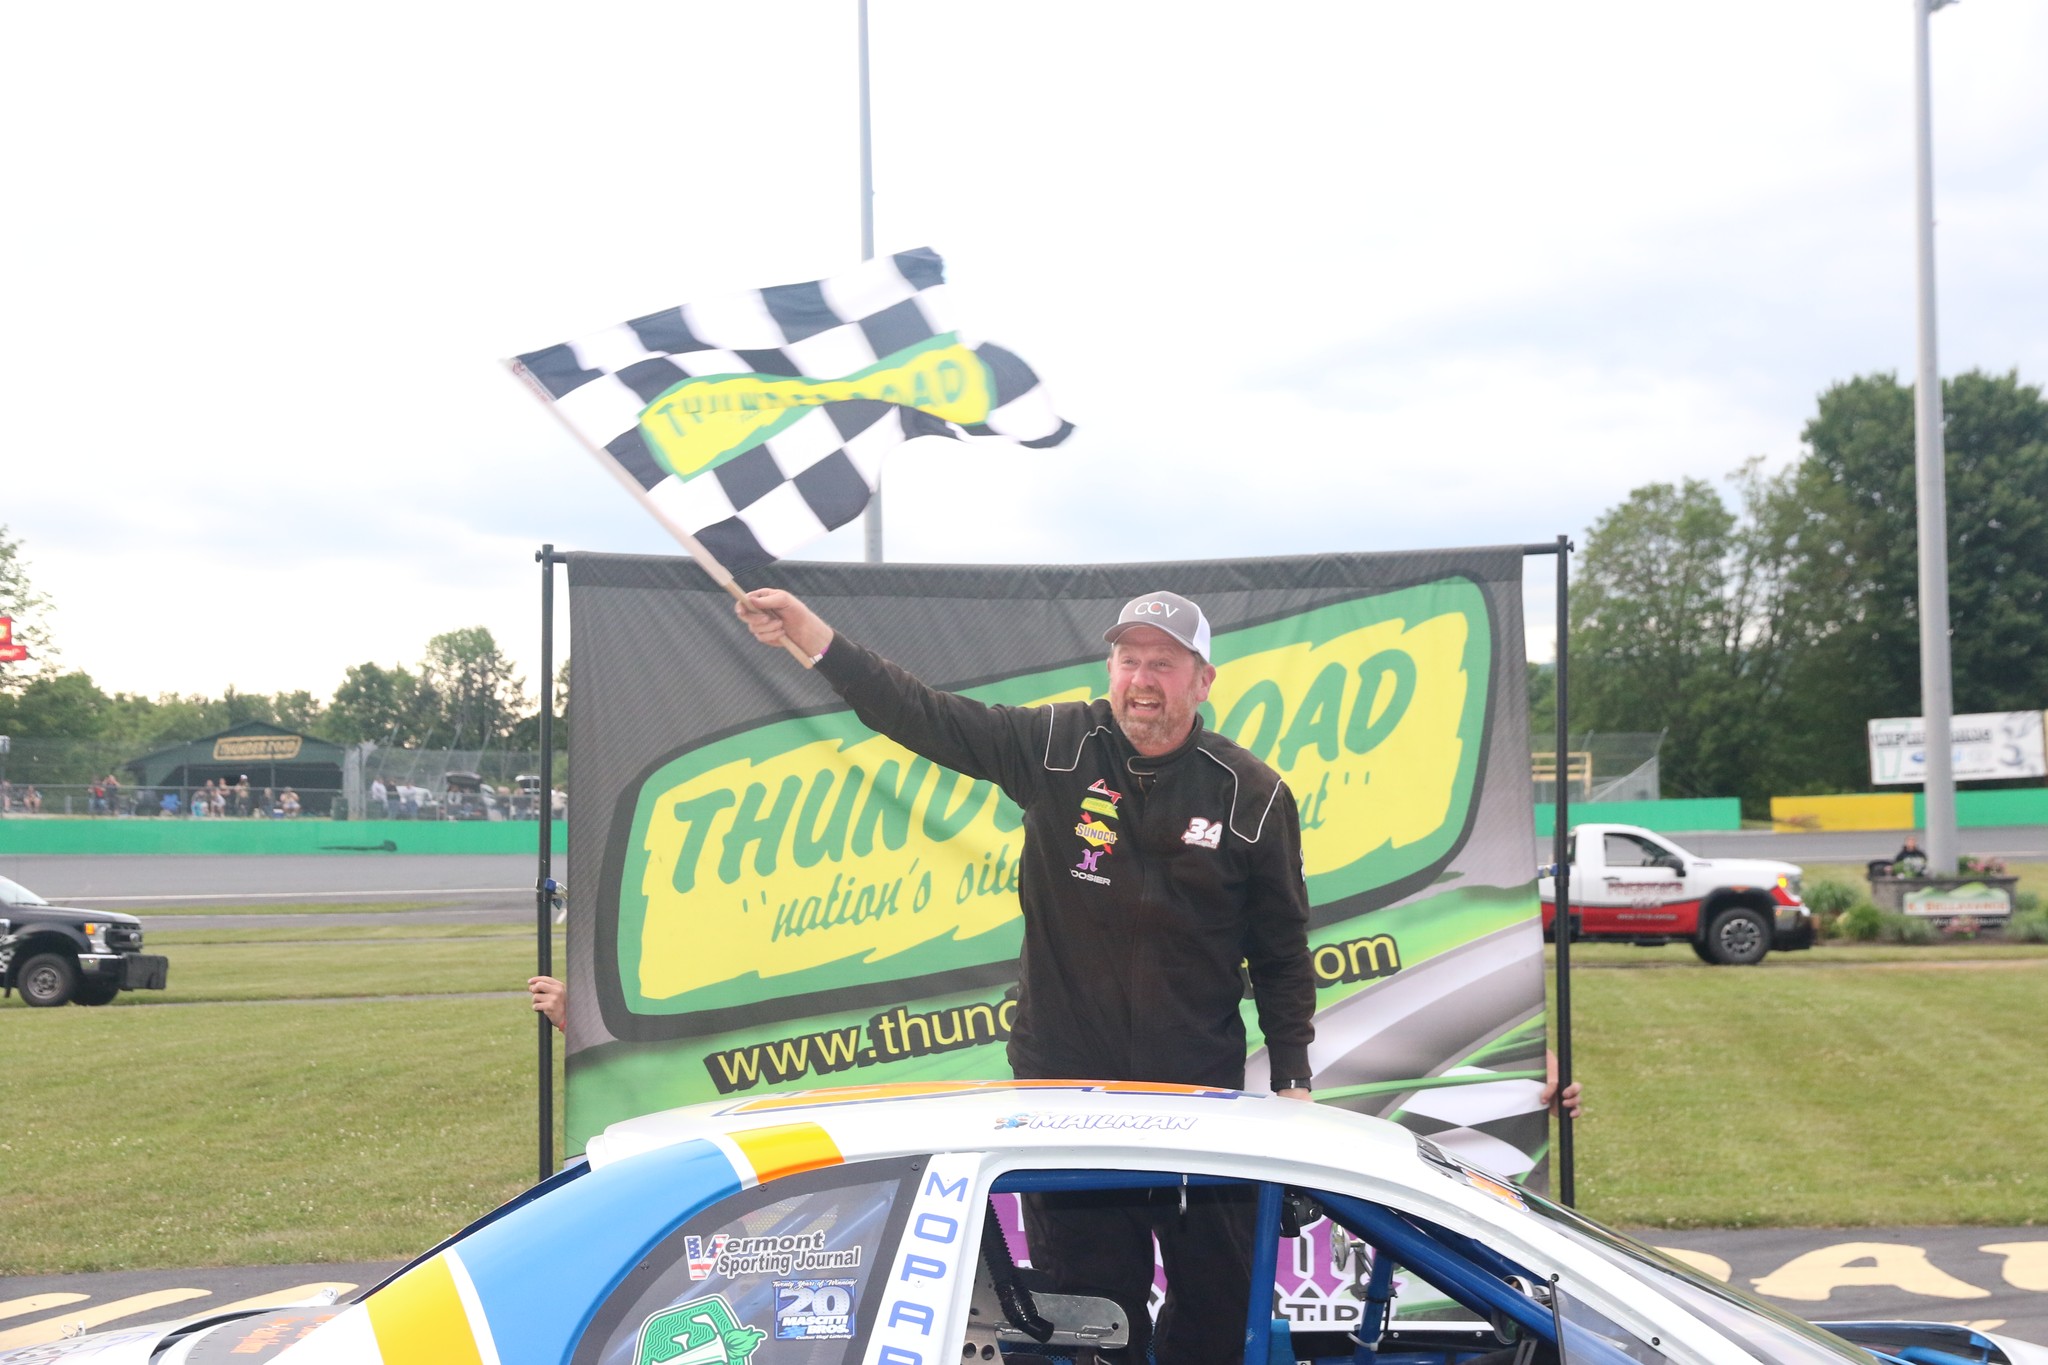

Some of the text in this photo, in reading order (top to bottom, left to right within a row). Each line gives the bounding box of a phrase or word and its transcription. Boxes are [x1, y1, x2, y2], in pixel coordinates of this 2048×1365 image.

[1134, 601, 1180, 618] CCV
[672, 648, 1417, 894] THUND OAD
[1076, 822, 1117, 844] SUNOCO
[1182, 817, 1222, 845] 34
[1070, 868, 1111, 886] OOSIER
[1029, 1114, 1199, 1131] MAILMAN
[684, 1230, 826, 1281] Vermont
[717, 1246, 862, 1278] Sporting Journal
[777, 1286, 850, 1322] 20
[781, 1315, 849, 1327] MASCITTI
[806, 1325, 850, 1335] BROS.
